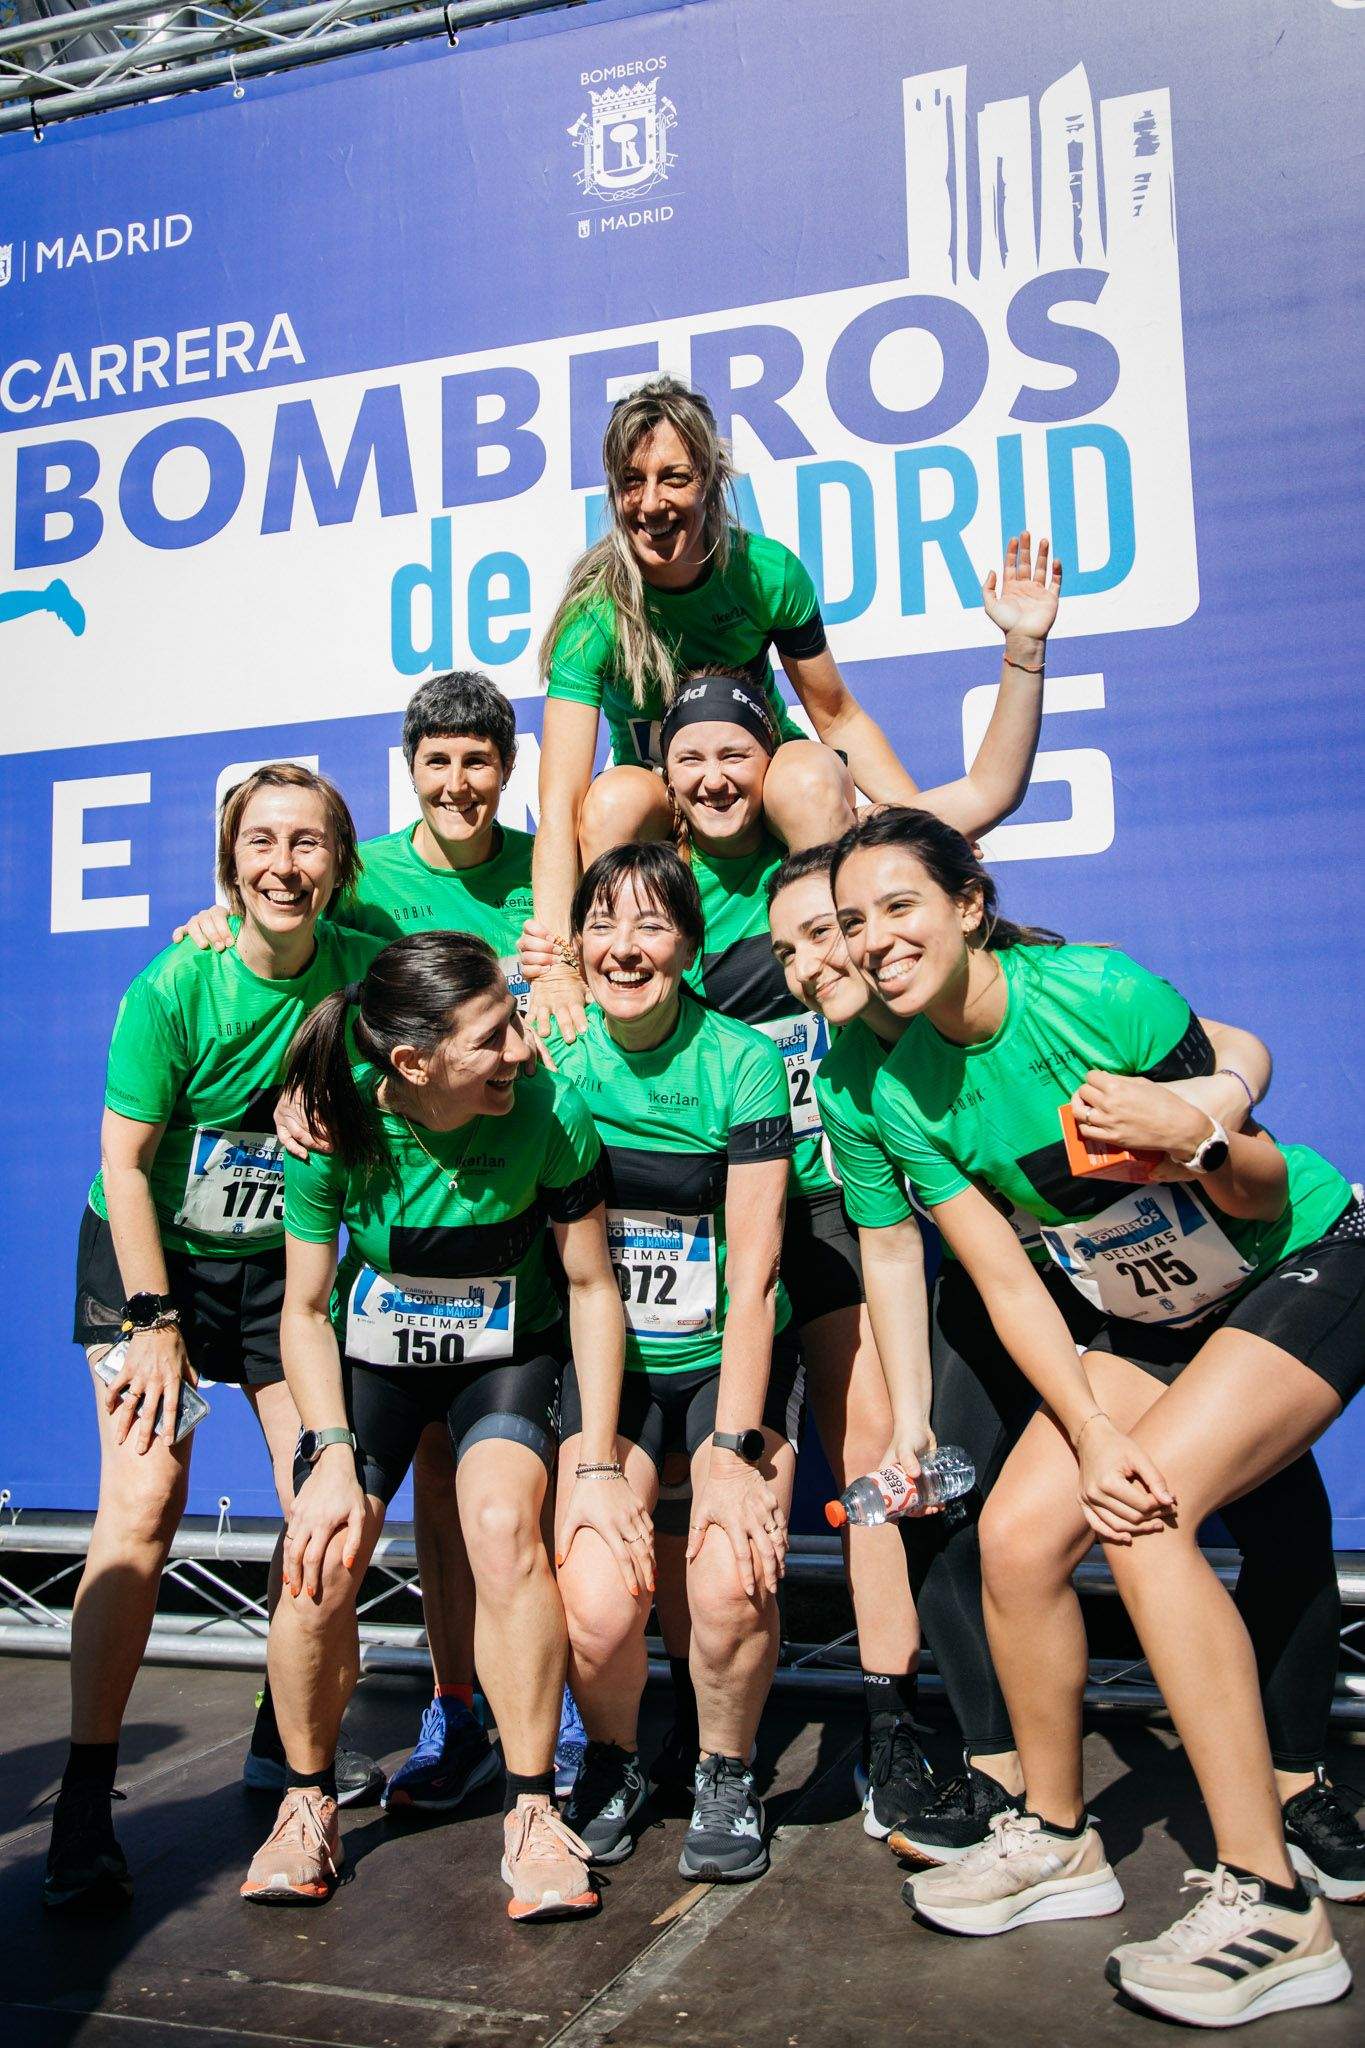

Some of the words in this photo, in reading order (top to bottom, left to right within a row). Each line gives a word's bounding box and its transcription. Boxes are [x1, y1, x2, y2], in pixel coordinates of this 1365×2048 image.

[580, 56, 667, 85] BOMBEROS
[601, 206, 674, 232] MADRID
[36, 213, 193, 274] MADRID
[0, 312, 306, 414] CARRERA
[390, 515, 531, 676] de
[584, 423, 1137, 626] DRID
[393, 905, 434, 920] GOBIK
[494, 895, 534, 909] ikerla
[776, 1033, 805, 1048] EROS
[647, 1089, 699, 1106] ikerlan
[247, 1147, 285, 1162] BOMB
[233, 1167, 285, 1183] DECIM
[610, 1248, 679, 1261] ECIMAS
[633, 1236, 644, 1247] de
[646, 1238, 680, 1249] MADRID
[1101, 1230, 1178, 1262] DECIMAS
[1116, 1249, 1198, 1298] 275
[403, 1293, 482, 1308] BOMBEROS
[432, 1304, 444, 1316] de
[445, 1306, 481, 1318] MADRID
[394, 1313, 478, 1330] DECIMAS
[392, 1327, 466, 1365] 150
[879, 1470, 901, 1496] ZERO
